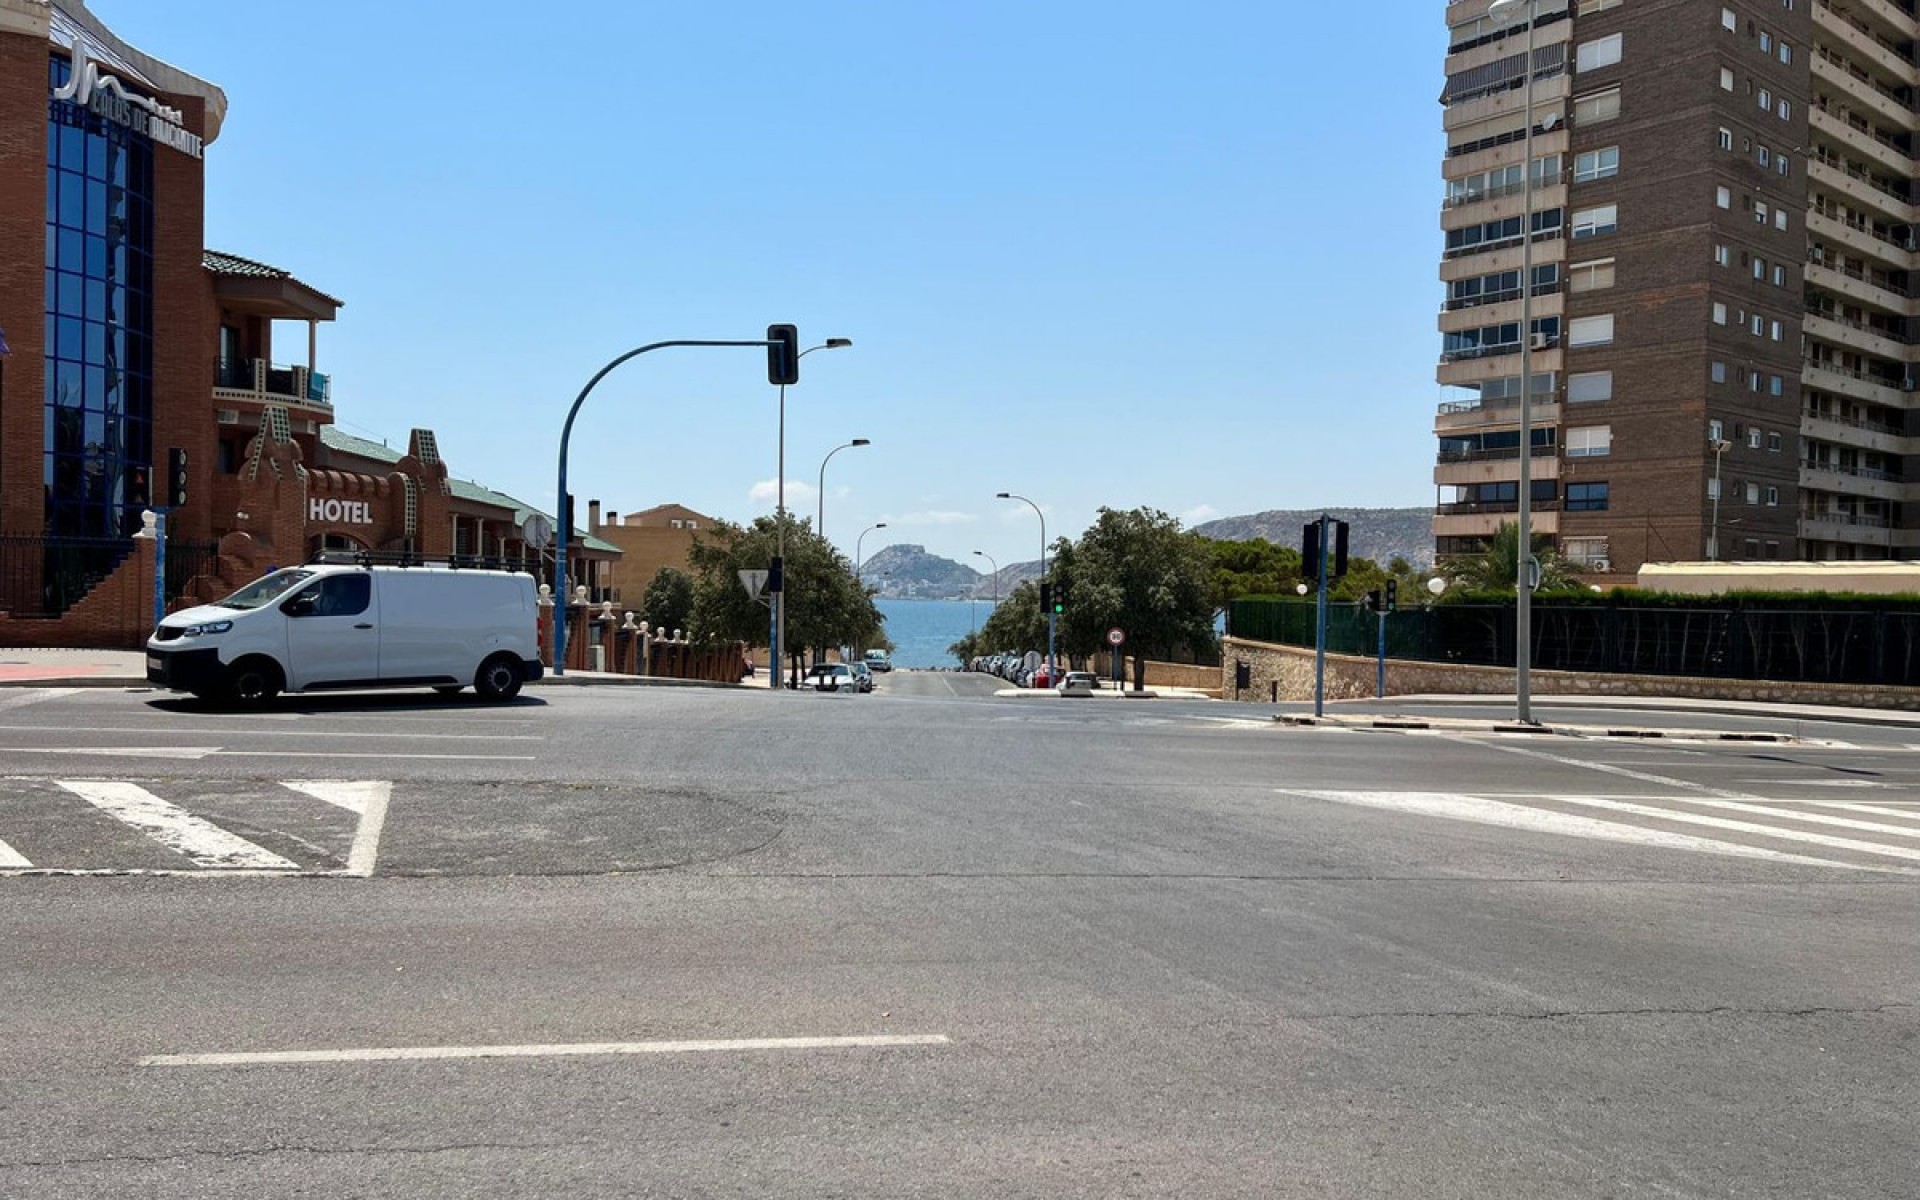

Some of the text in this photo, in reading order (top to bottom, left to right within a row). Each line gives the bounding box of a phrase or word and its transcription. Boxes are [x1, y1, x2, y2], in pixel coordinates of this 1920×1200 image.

[91, 89, 130, 127] CALAS
[132, 108, 148, 135] DE
[310, 498, 373, 523] HOTEL
